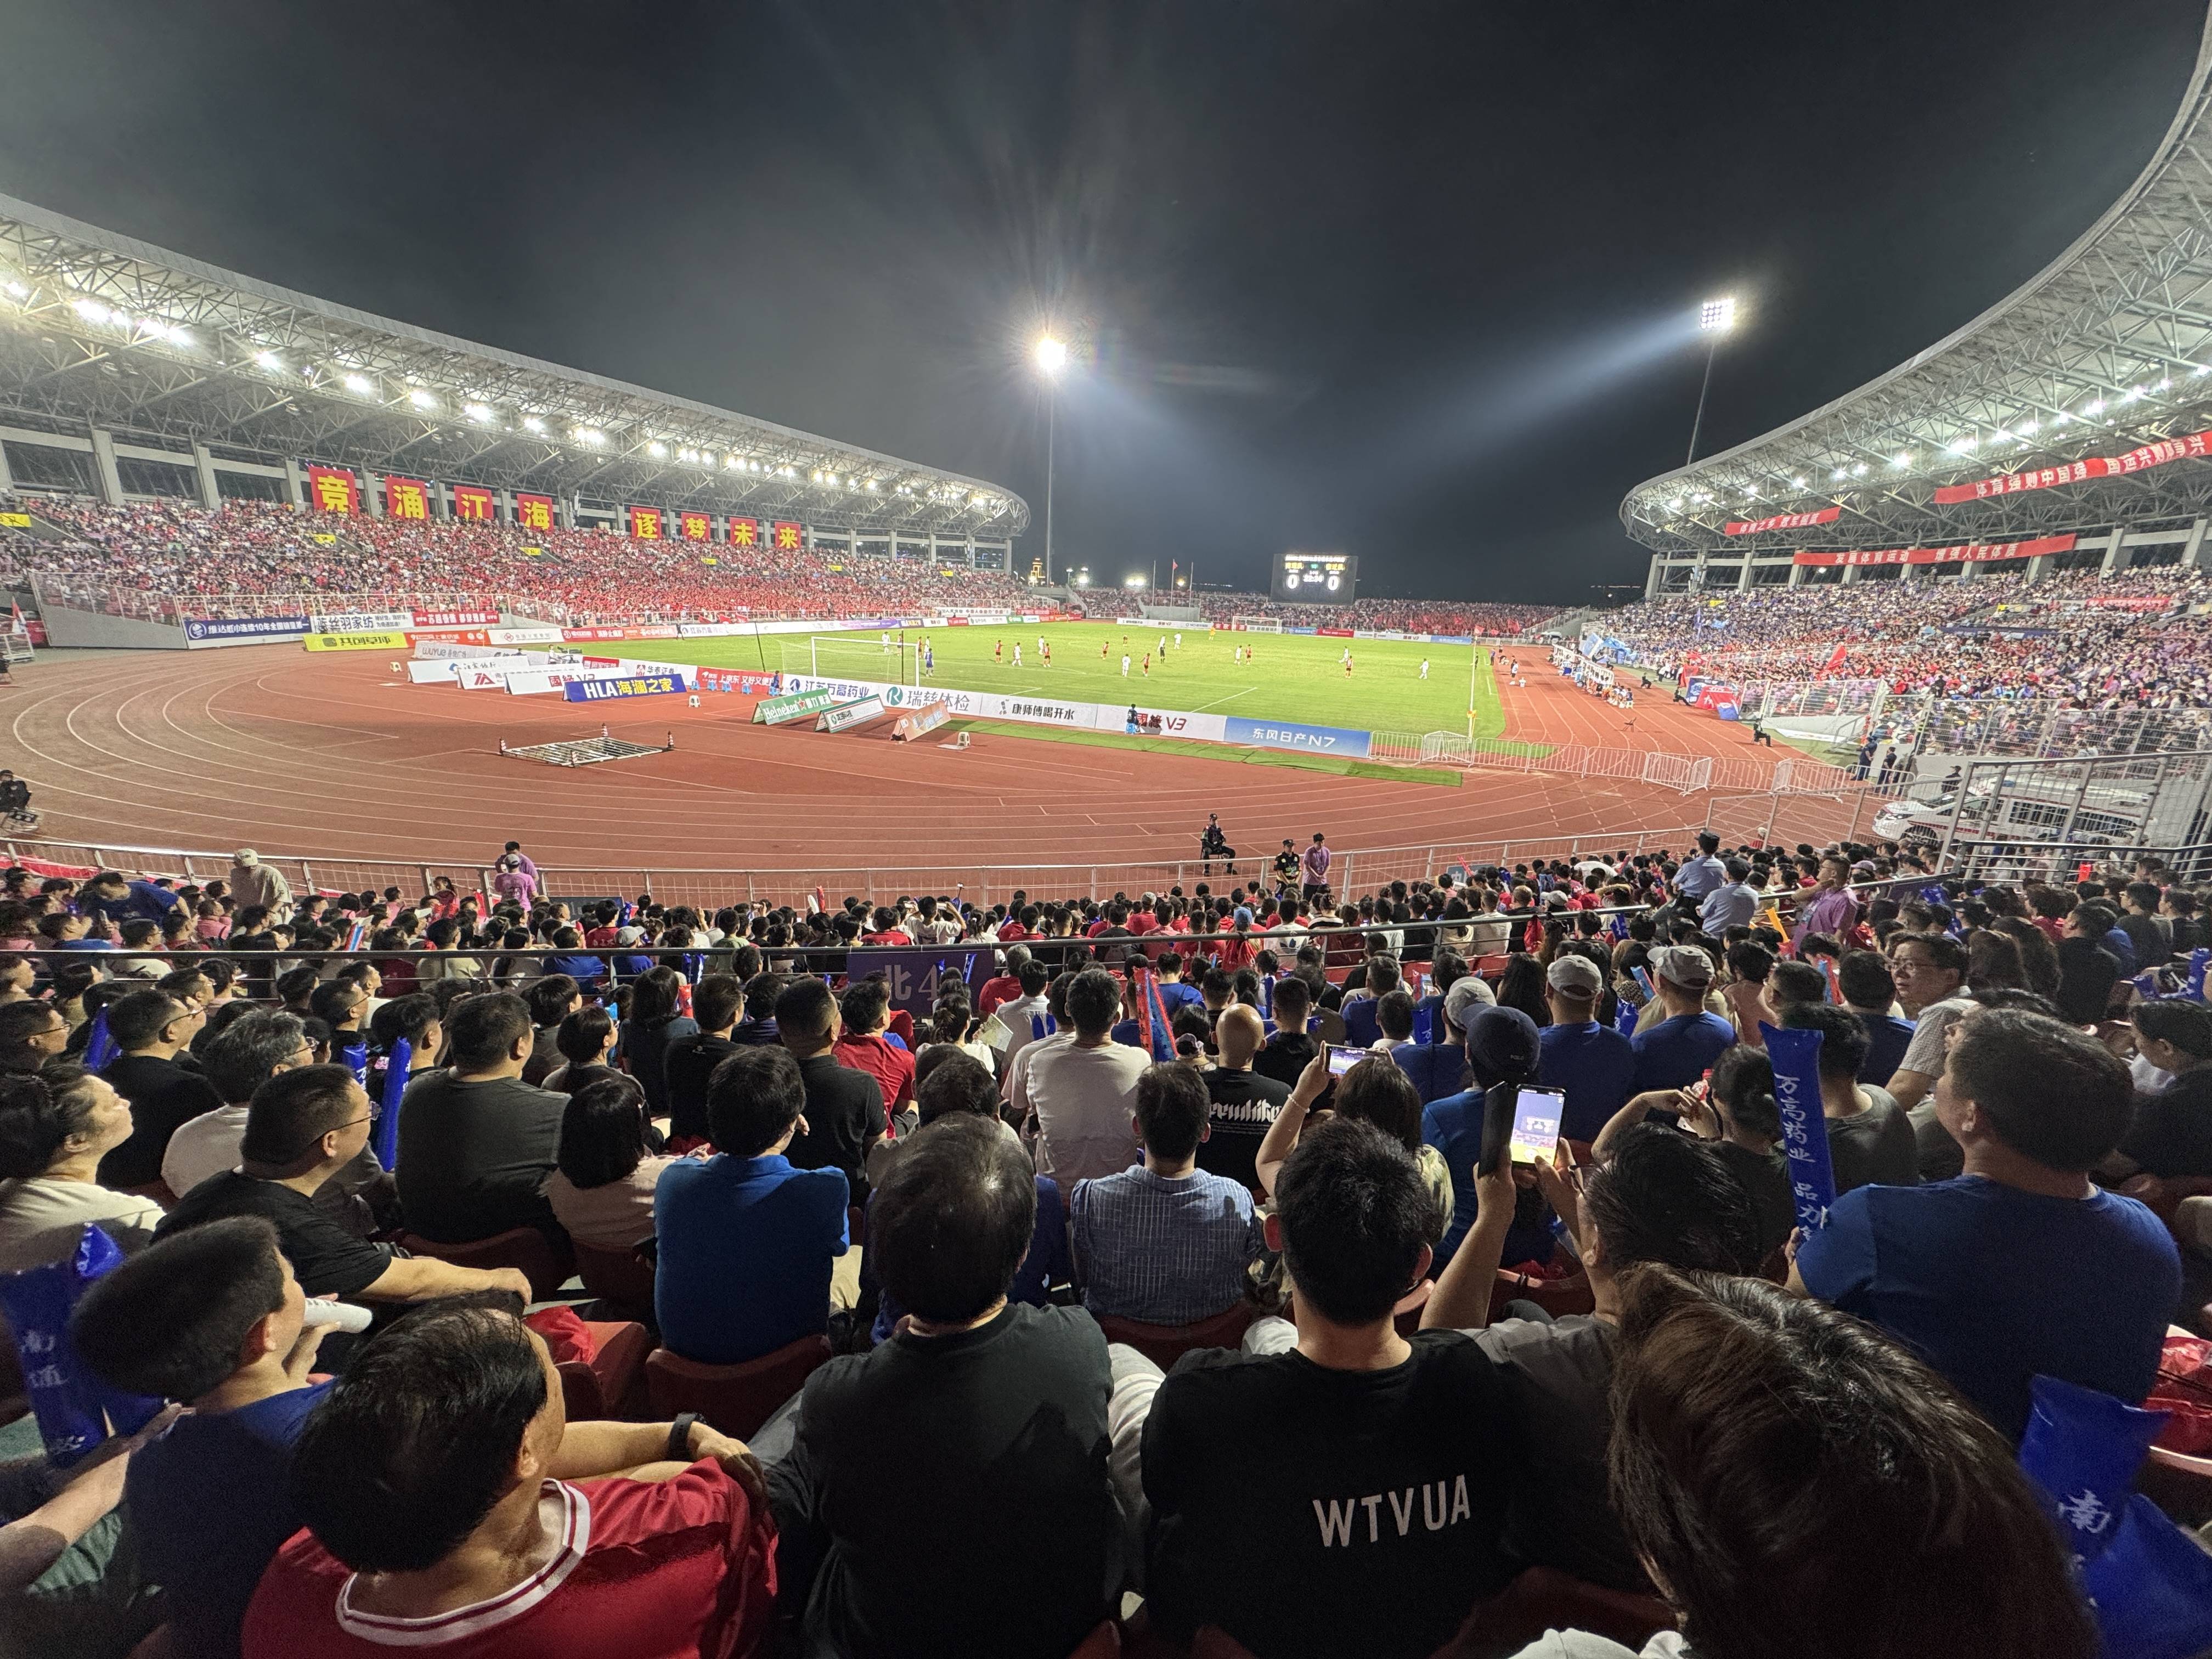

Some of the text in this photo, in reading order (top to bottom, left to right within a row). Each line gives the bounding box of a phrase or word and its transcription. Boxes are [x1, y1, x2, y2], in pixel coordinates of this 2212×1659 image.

[318, 476, 349, 512] 竞
[393, 485, 425, 519] 涌
[461, 494, 487, 521] 江
[524, 501, 549, 530] 海
[635, 512, 657, 539] 逐
[686, 518, 706, 539] 梦
[735, 523, 753, 545] 未
[779, 527, 798, 549] 来
[1835, 550, 1910, 565] 发展体育运动
[719, 674, 741, 684] 上京东
[763, 701, 799, 720] Heineken
[906, 691, 970, 711] 瑞慈体检
[1012, 703, 1075, 720] 康师傅喝开水
[1166, 716, 1187, 731] V3
[1253, 728, 1335, 748] 东风日产N7
[1312, 1474, 1471, 1548] WTVUA
